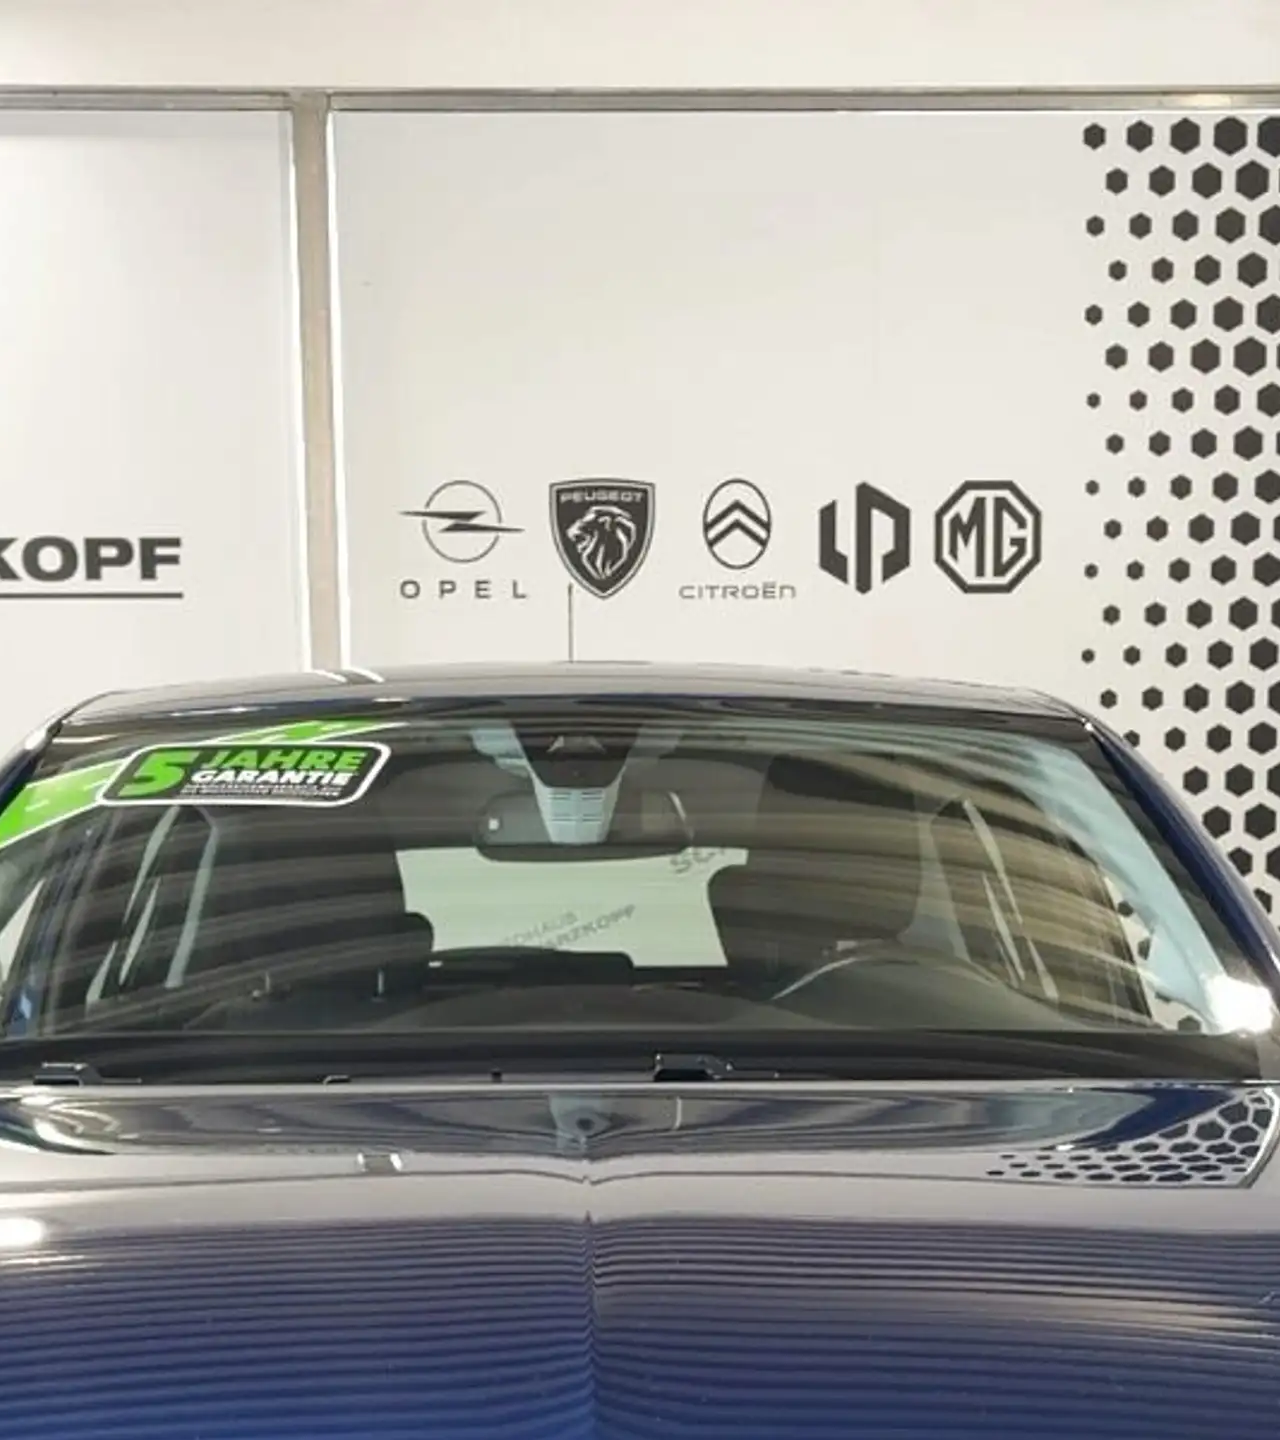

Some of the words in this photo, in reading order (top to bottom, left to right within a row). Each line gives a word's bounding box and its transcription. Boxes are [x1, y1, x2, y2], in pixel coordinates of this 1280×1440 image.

[560, 490, 644, 502] PEUGEOT
[950, 497, 1026, 578] MG
[399, 580, 527, 600] OPEL
[201, 750, 368, 770] JAHRE
[118, 751, 200, 797] 5
[191, 769, 354, 786] GARANTIE
